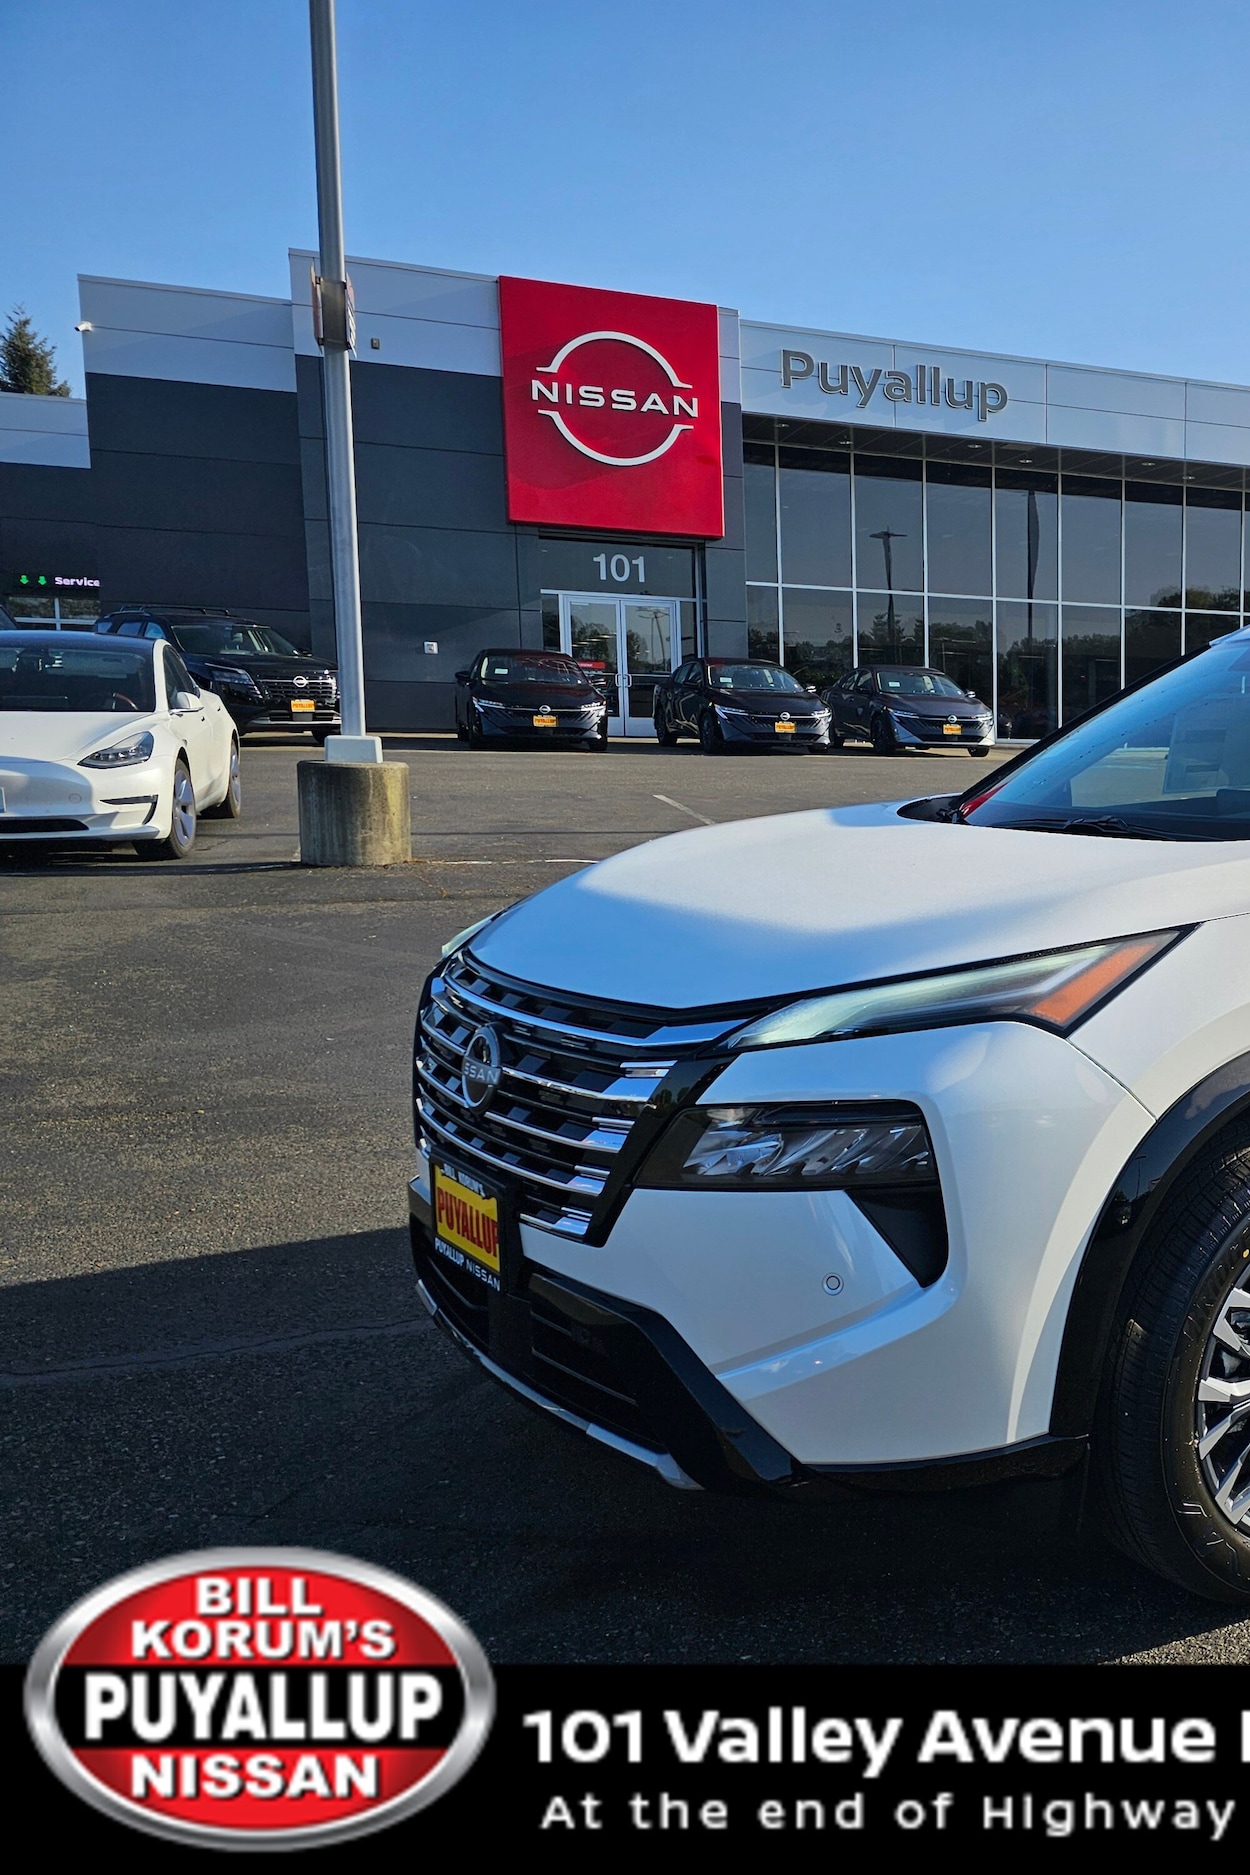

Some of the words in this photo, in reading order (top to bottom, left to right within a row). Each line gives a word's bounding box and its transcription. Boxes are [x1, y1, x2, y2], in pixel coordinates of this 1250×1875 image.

[531, 379, 698, 418] NISSAN
[781, 349, 1008, 421] Puyallup
[54, 576, 100, 587] Service
[593, 553, 645, 583] 101
[464, 1062, 499, 1083] SSAN
[465, 1258, 500, 1292] NISSAN
